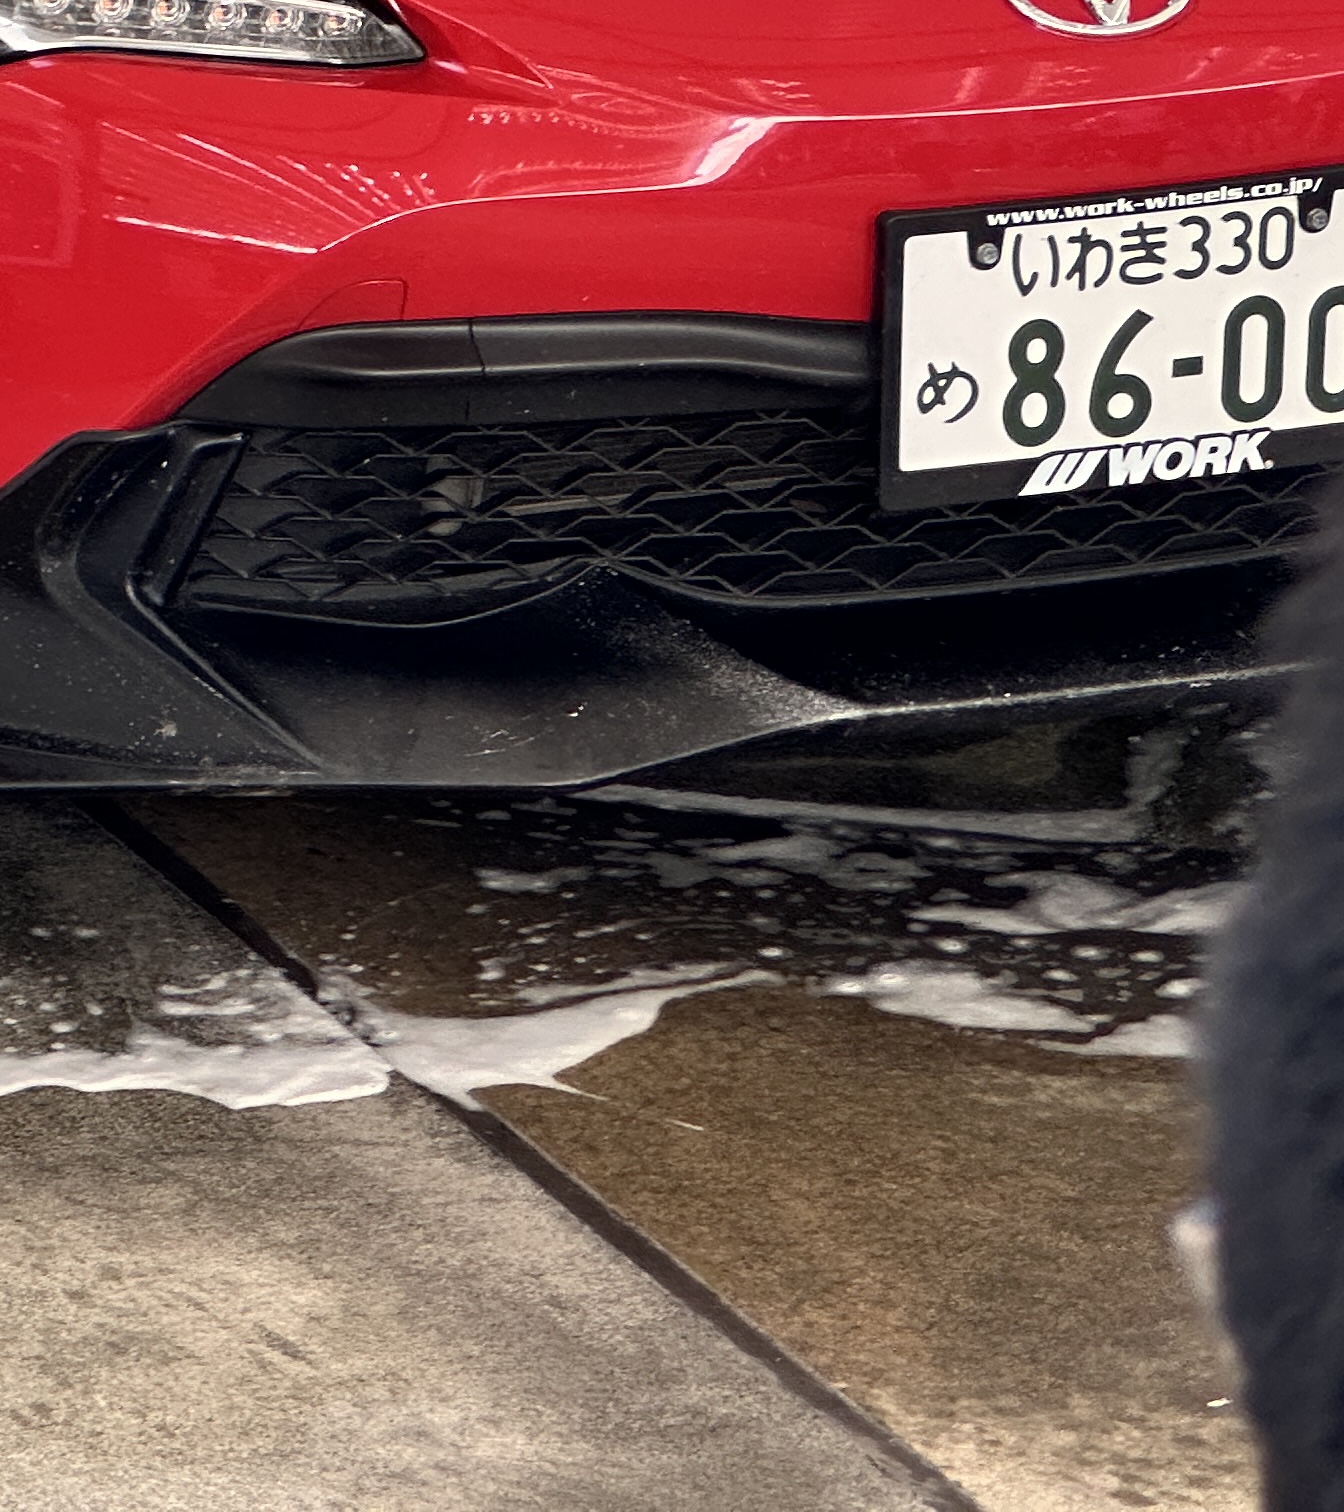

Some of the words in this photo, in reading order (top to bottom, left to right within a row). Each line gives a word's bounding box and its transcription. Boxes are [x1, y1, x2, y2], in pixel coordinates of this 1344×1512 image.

[985, 176, 1325, 227] www.work-wheels.co.jp/
[916, 360, 979, 424] め
[1107, 428, 1276, 488] WORK
